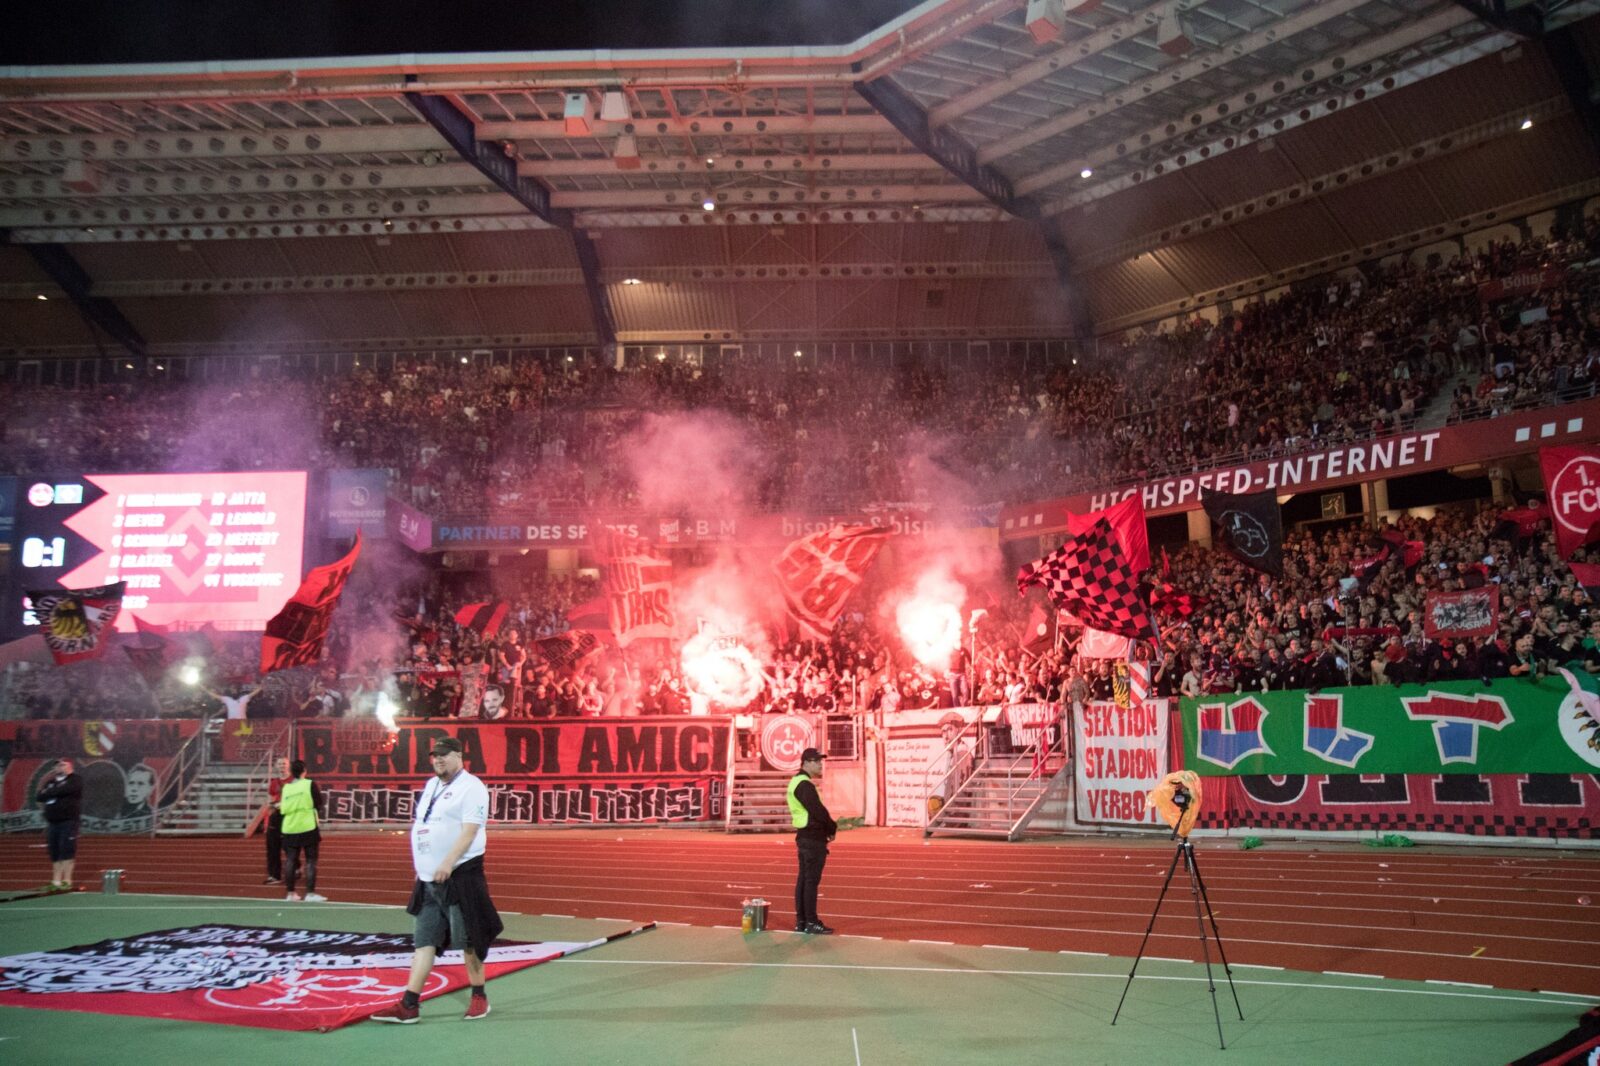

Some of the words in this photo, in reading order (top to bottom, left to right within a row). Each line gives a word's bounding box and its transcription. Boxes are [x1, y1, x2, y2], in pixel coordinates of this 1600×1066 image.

[1562, 486, 1600, 514] FC
[439, 526, 521, 541] PARTNER
[526, 524, 562, 540] DES
[1083, 704, 1157, 737] SEKTION
[504, 727, 560, 773] DI
[578, 726, 729, 773] AMICI
[773, 740, 804, 755] FCN
[1085, 747, 1158, 779] STADION
[541, 787, 704, 822] ULTRAS!
